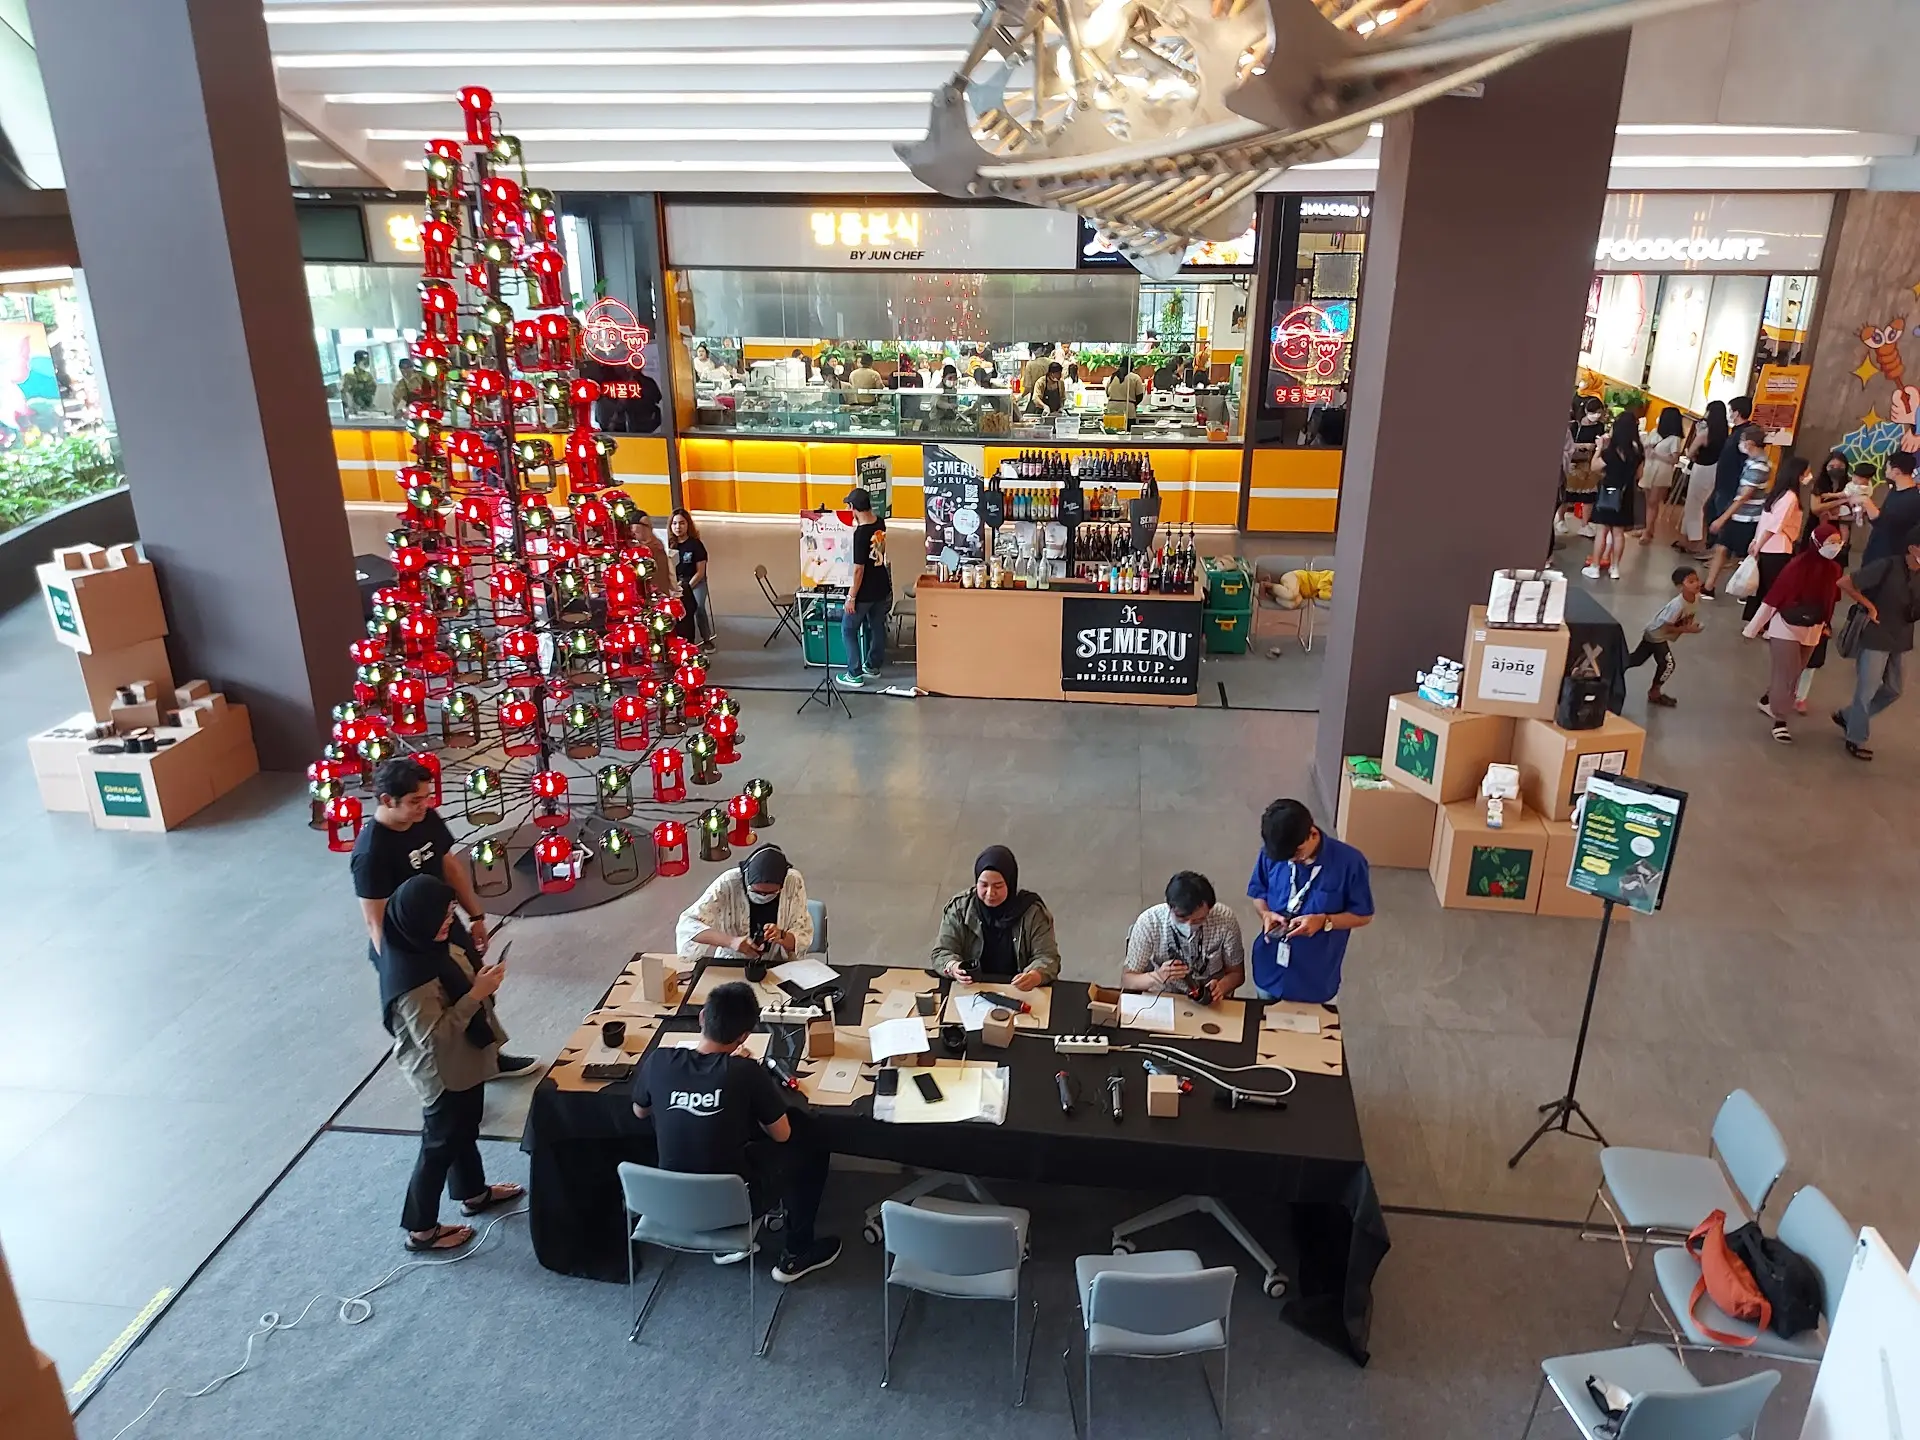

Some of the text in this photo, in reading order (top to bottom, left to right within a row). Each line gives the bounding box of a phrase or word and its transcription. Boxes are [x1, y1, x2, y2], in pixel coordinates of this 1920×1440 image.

[849, 250, 925, 260] BY JUN CHEF
[603, 383, 642, 398] 개꿀맛
[928, 460, 977, 478] SEMERU
[937, 476, 968, 485] SIRUP
[1076, 627, 1188, 661] SEMERU
[1097, 659, 1165, 674] SIRUP
[1076, 673, 1188, 684] WWW.SEMERUOCEAN.COM
[669, 1088, 723, 1110] rapel
